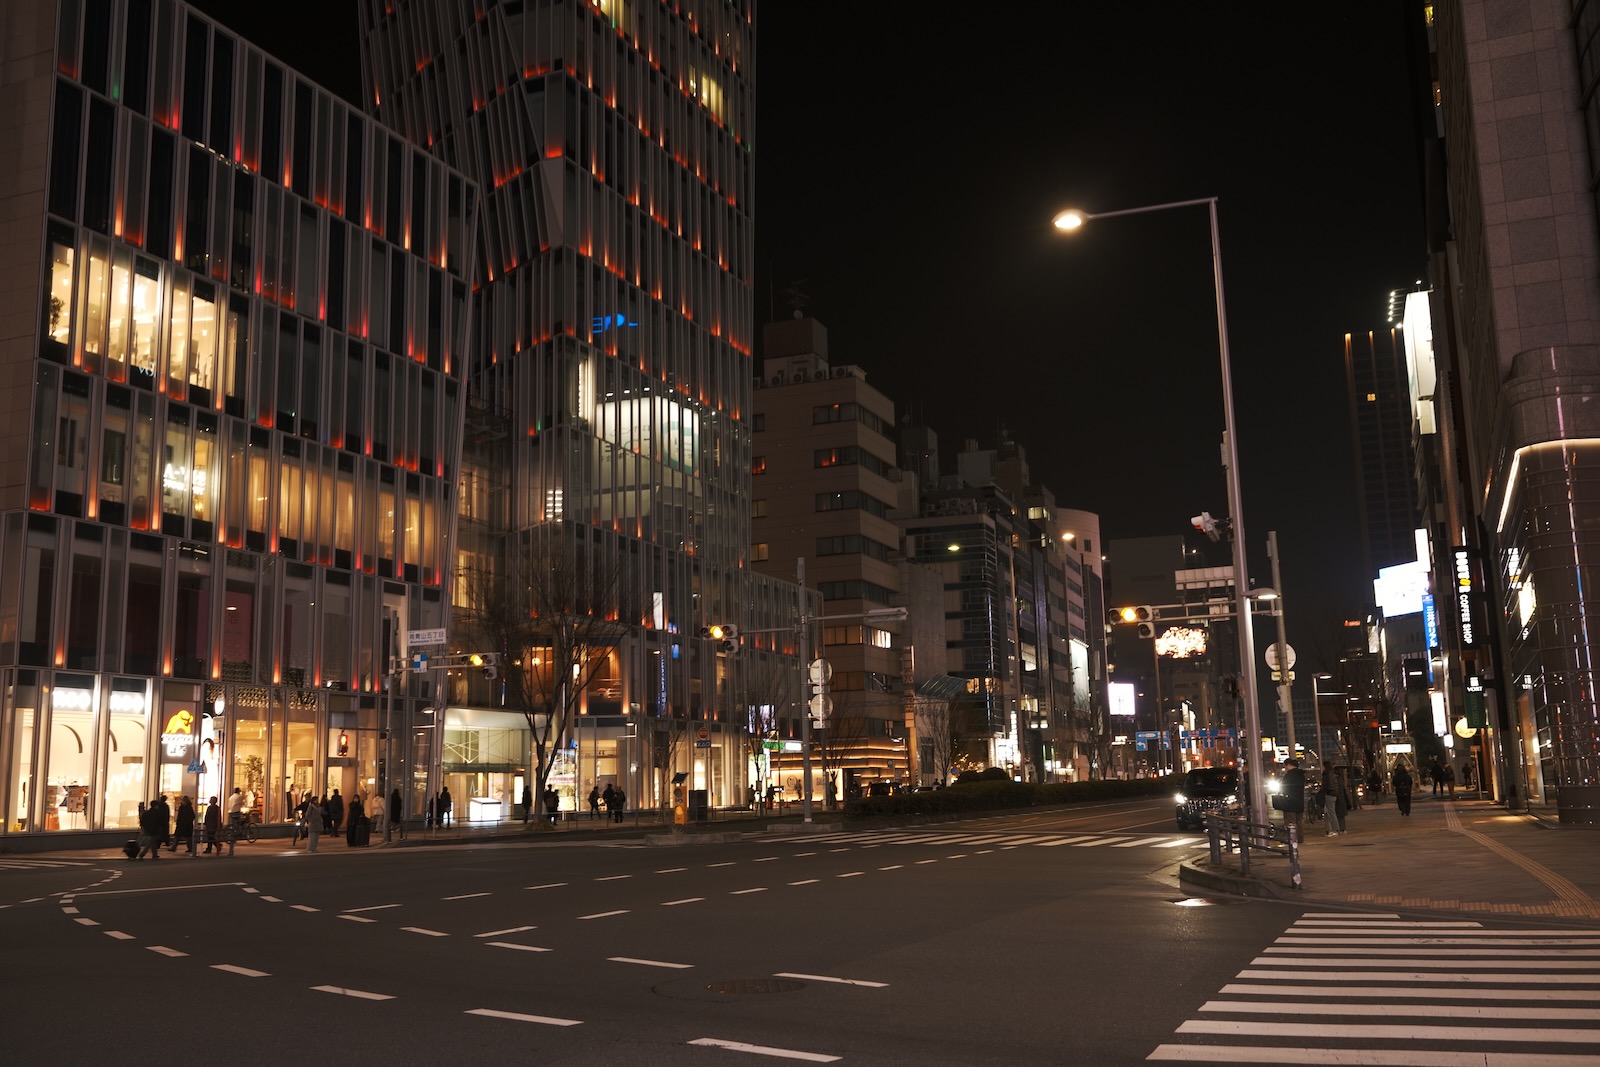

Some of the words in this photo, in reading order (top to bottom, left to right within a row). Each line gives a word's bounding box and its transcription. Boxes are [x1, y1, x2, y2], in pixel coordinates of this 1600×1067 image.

[1456, 552, 1471, 593] DOUTOR
[1459, 594, 1471, 622] COFFEE
[409, 631, 444, 640] 南青山五丁目
[1462, 624, 1473, 644] SHOP
